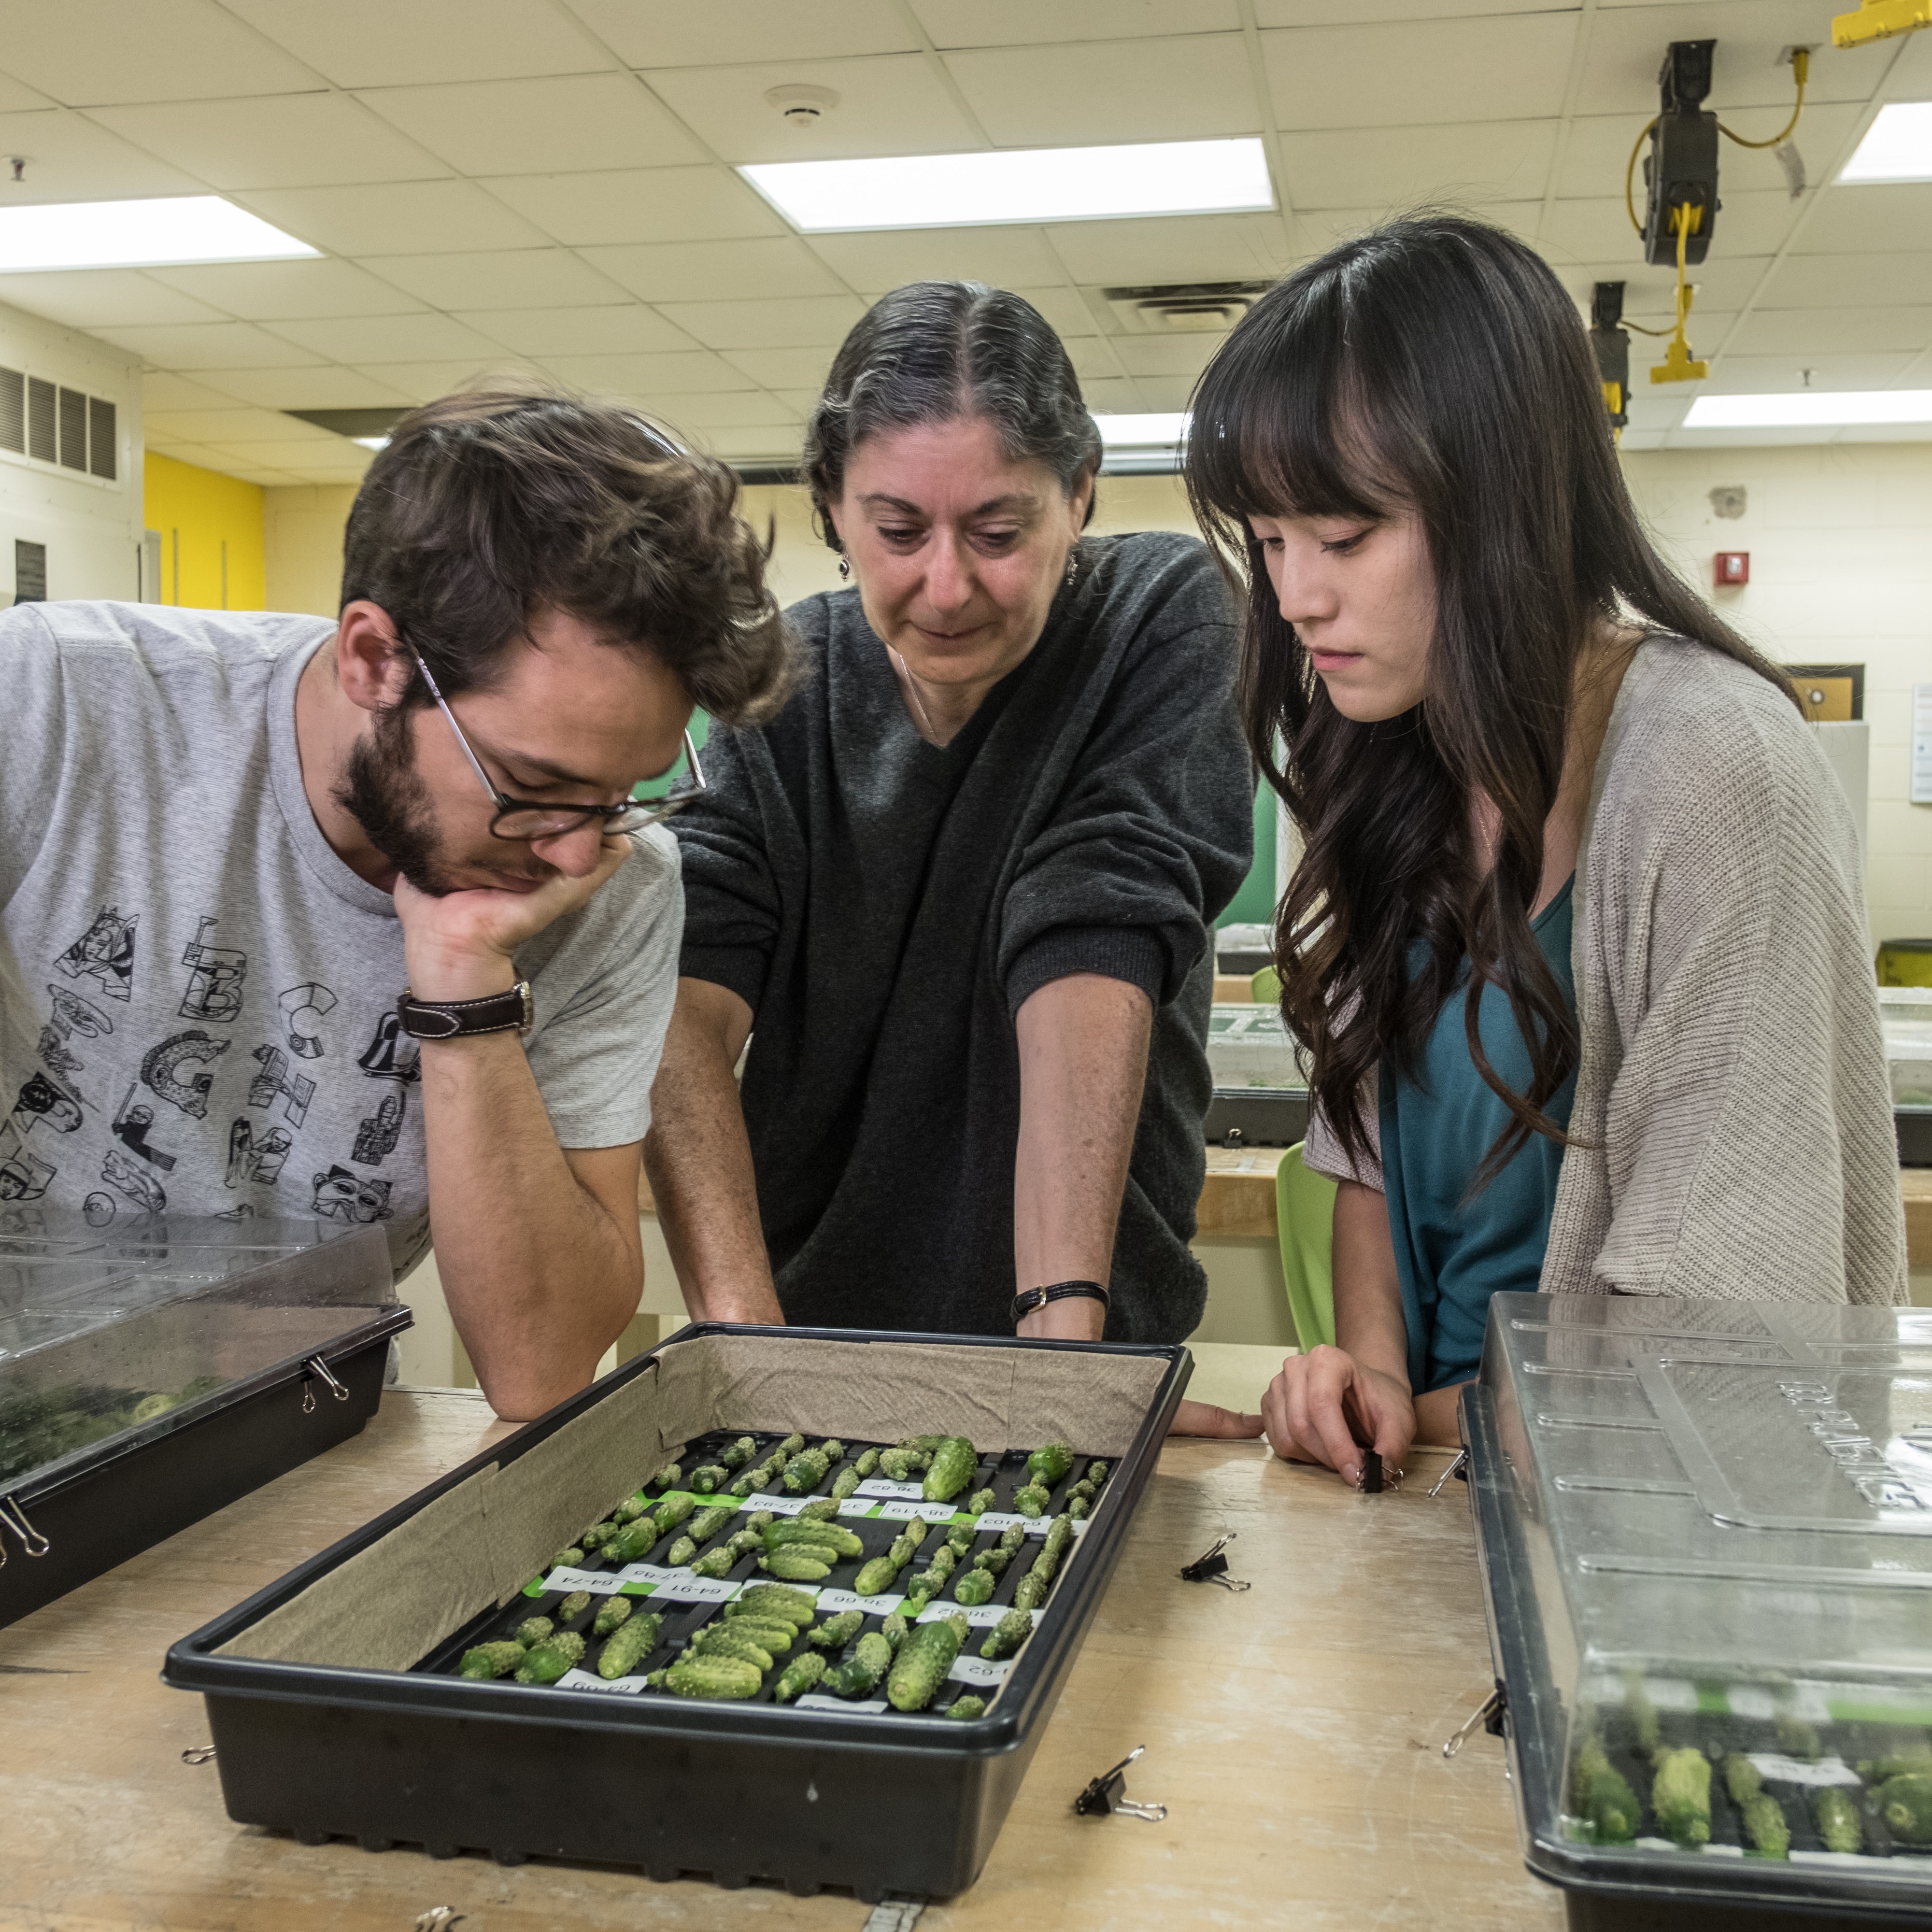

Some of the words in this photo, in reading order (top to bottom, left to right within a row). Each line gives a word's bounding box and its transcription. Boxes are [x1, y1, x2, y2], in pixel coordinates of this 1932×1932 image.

[891, 1507, 949, 1516] 38-119
[983, 1519, 1041, 1527] 64103
[561, 1576, 612, 1587] 64-74
[671, 1584, 722, 1595] 64-91
